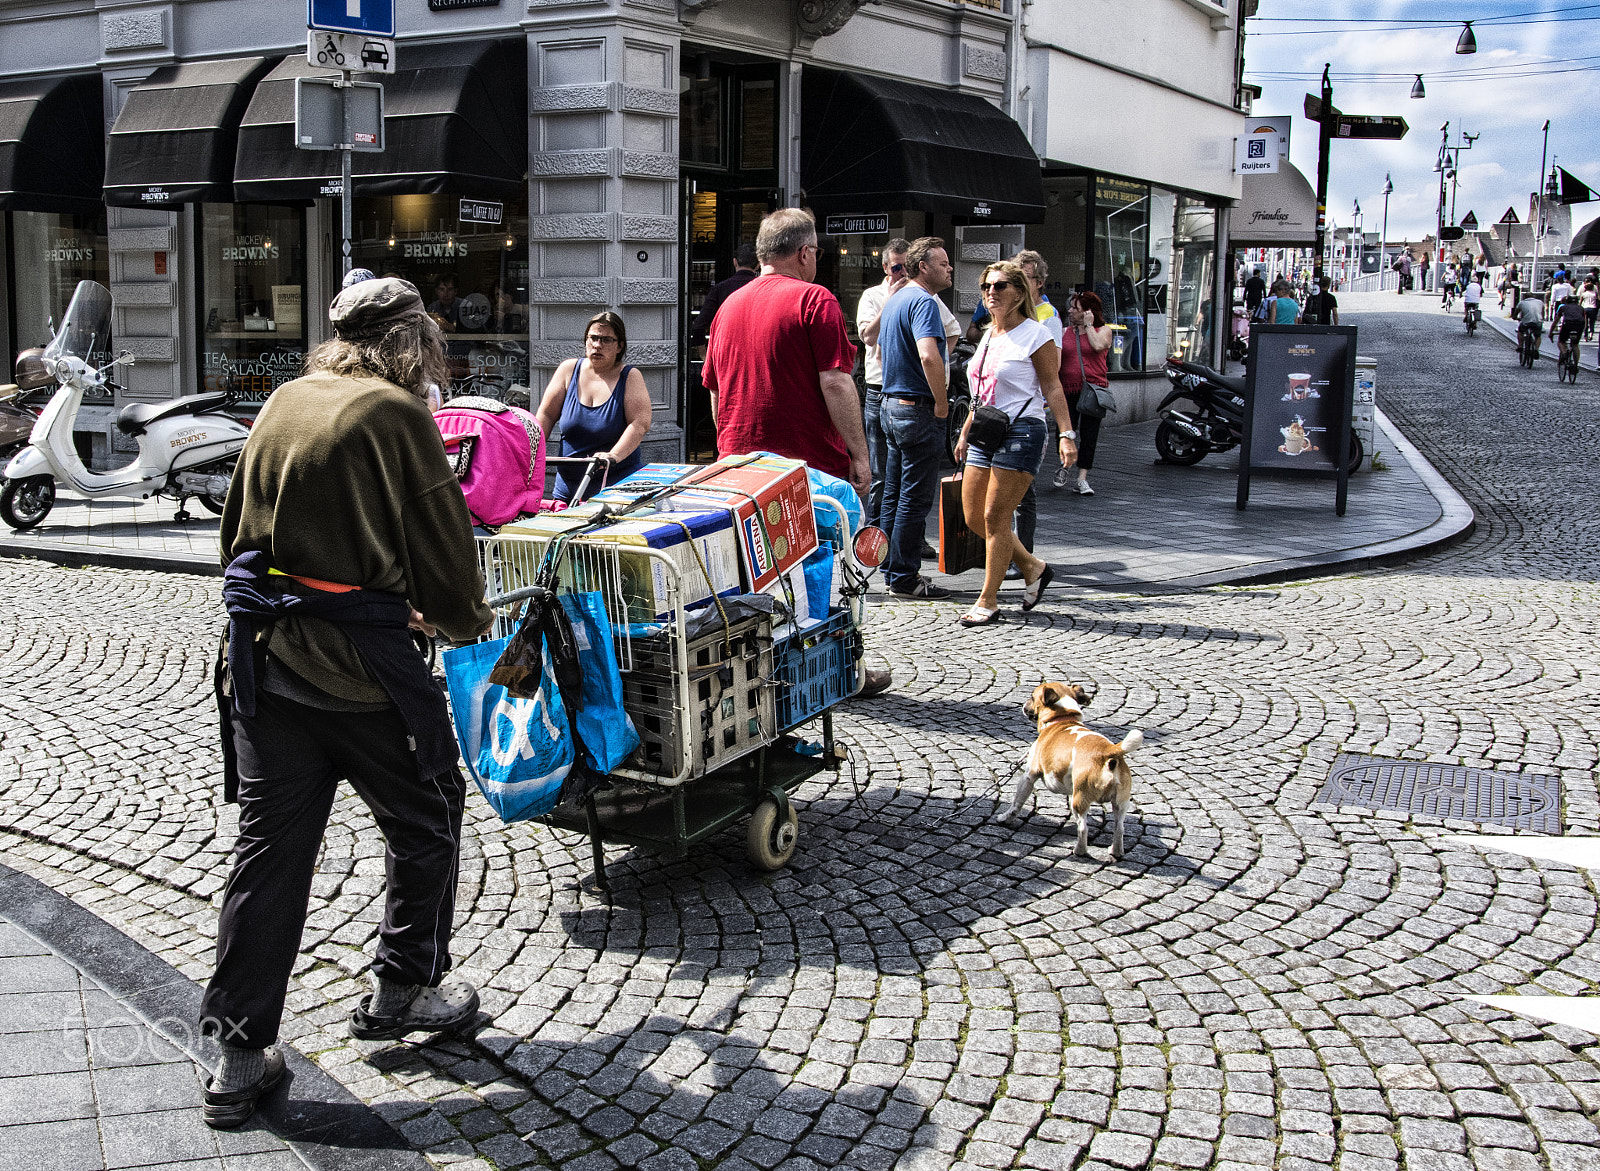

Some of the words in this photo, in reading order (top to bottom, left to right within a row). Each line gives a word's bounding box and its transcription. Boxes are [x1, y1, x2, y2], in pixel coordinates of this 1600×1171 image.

[1241, 162, 1271, 170] Ruijters
[141, 192, 170, 200] BROWN'S
[1248, 207, 1290, 225] Friandises
[844, 219, 867, 231] COFFEE
[867, 219, 875, 231] TO
[876, 218, 886, 230] GO
[236, 234, 264, 246] MICKEY
[420, 230, 450, 242] MICKEY
[43, 248, 93, 261] BROWN'S
[222, 246, 280, 260] BROWN'S
[403, 242, 468, 258] BROWN'S
[203, 352, 229, 364] TEA
[259, 352, 303, 365] CAKES
[477, 355, 518, 367] SOUP
[222, 363, 274, 376] SALADS
[1231, 396, 1245, 407] BU
[170, 432, 207, 448] BROWN'S
[751, 518, 767, 570] ARDENA
